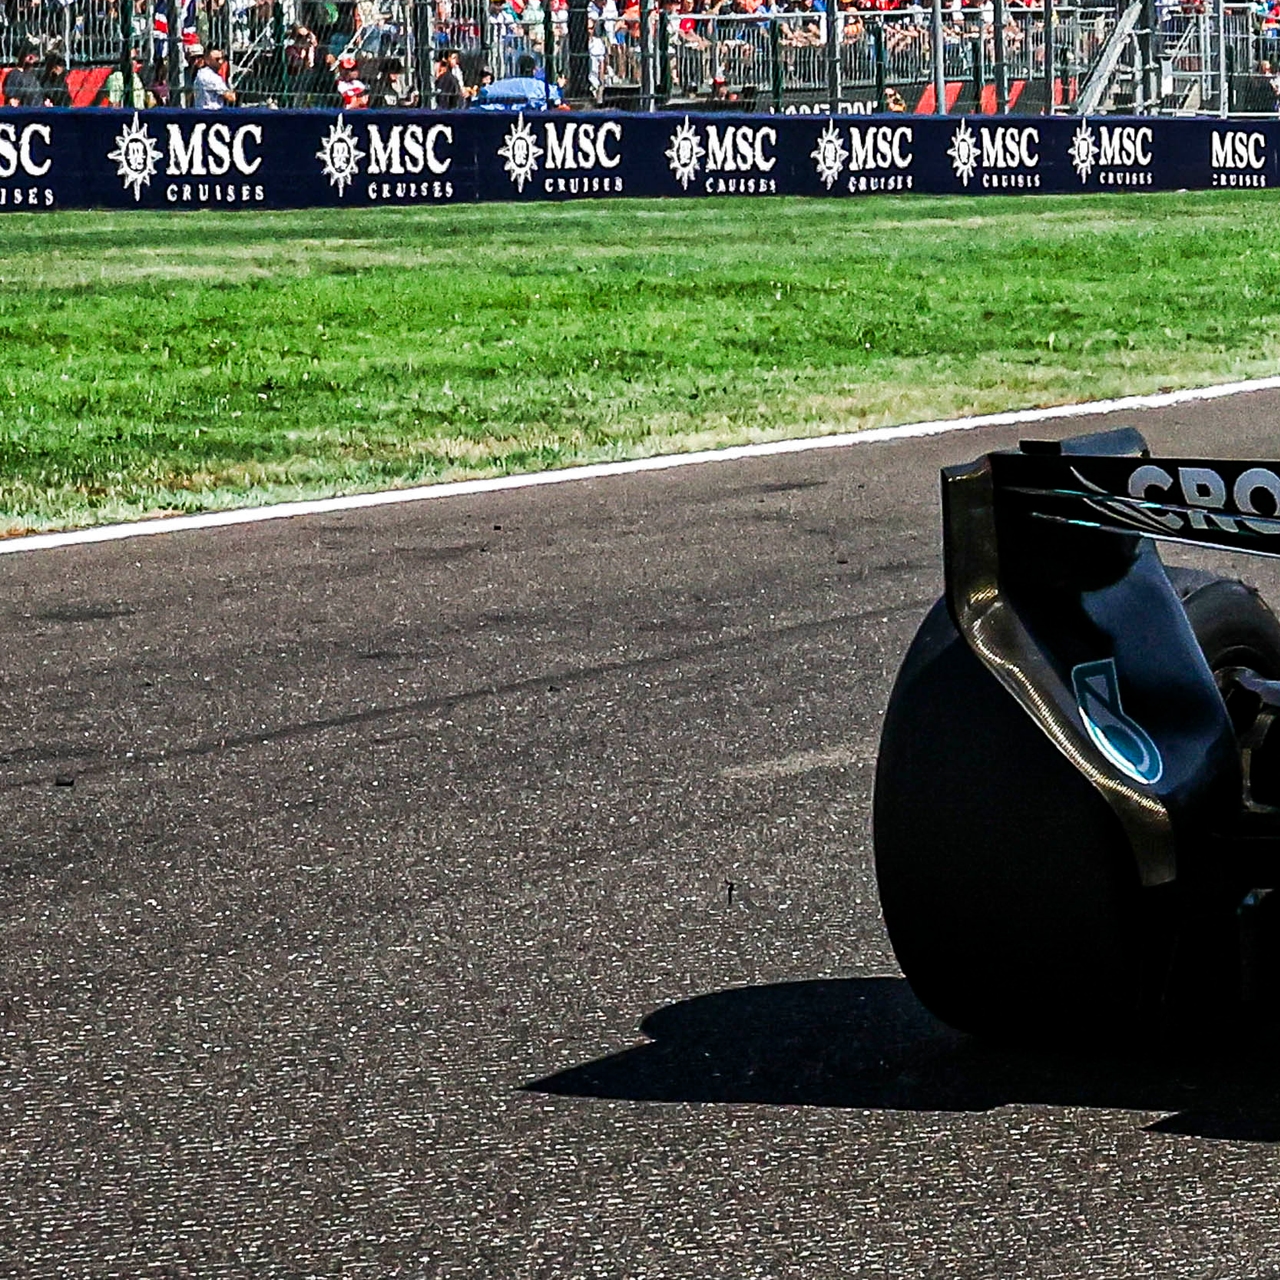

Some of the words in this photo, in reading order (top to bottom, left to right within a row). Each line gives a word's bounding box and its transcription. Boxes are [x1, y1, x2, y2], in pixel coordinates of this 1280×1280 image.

[0, 123, 51, 175] SC
[165, 123, 262, 175] MSC
[367, 123, 452, 174] MSC
[544, 121, 622, 168] MSC
[705, 125, 776, 171] MSC
[849, 126, 912, 170] MSC
[980, 126, 1039, 168] MSC
[1099, 126, 1152, 166] MSC
[1211, 130, 1265, 169] MSC
[166, 183, 265, 202] CRUISES
[368, 181, 453, 198] CRUISES
[544, 177, 623, 193] CRUISES
